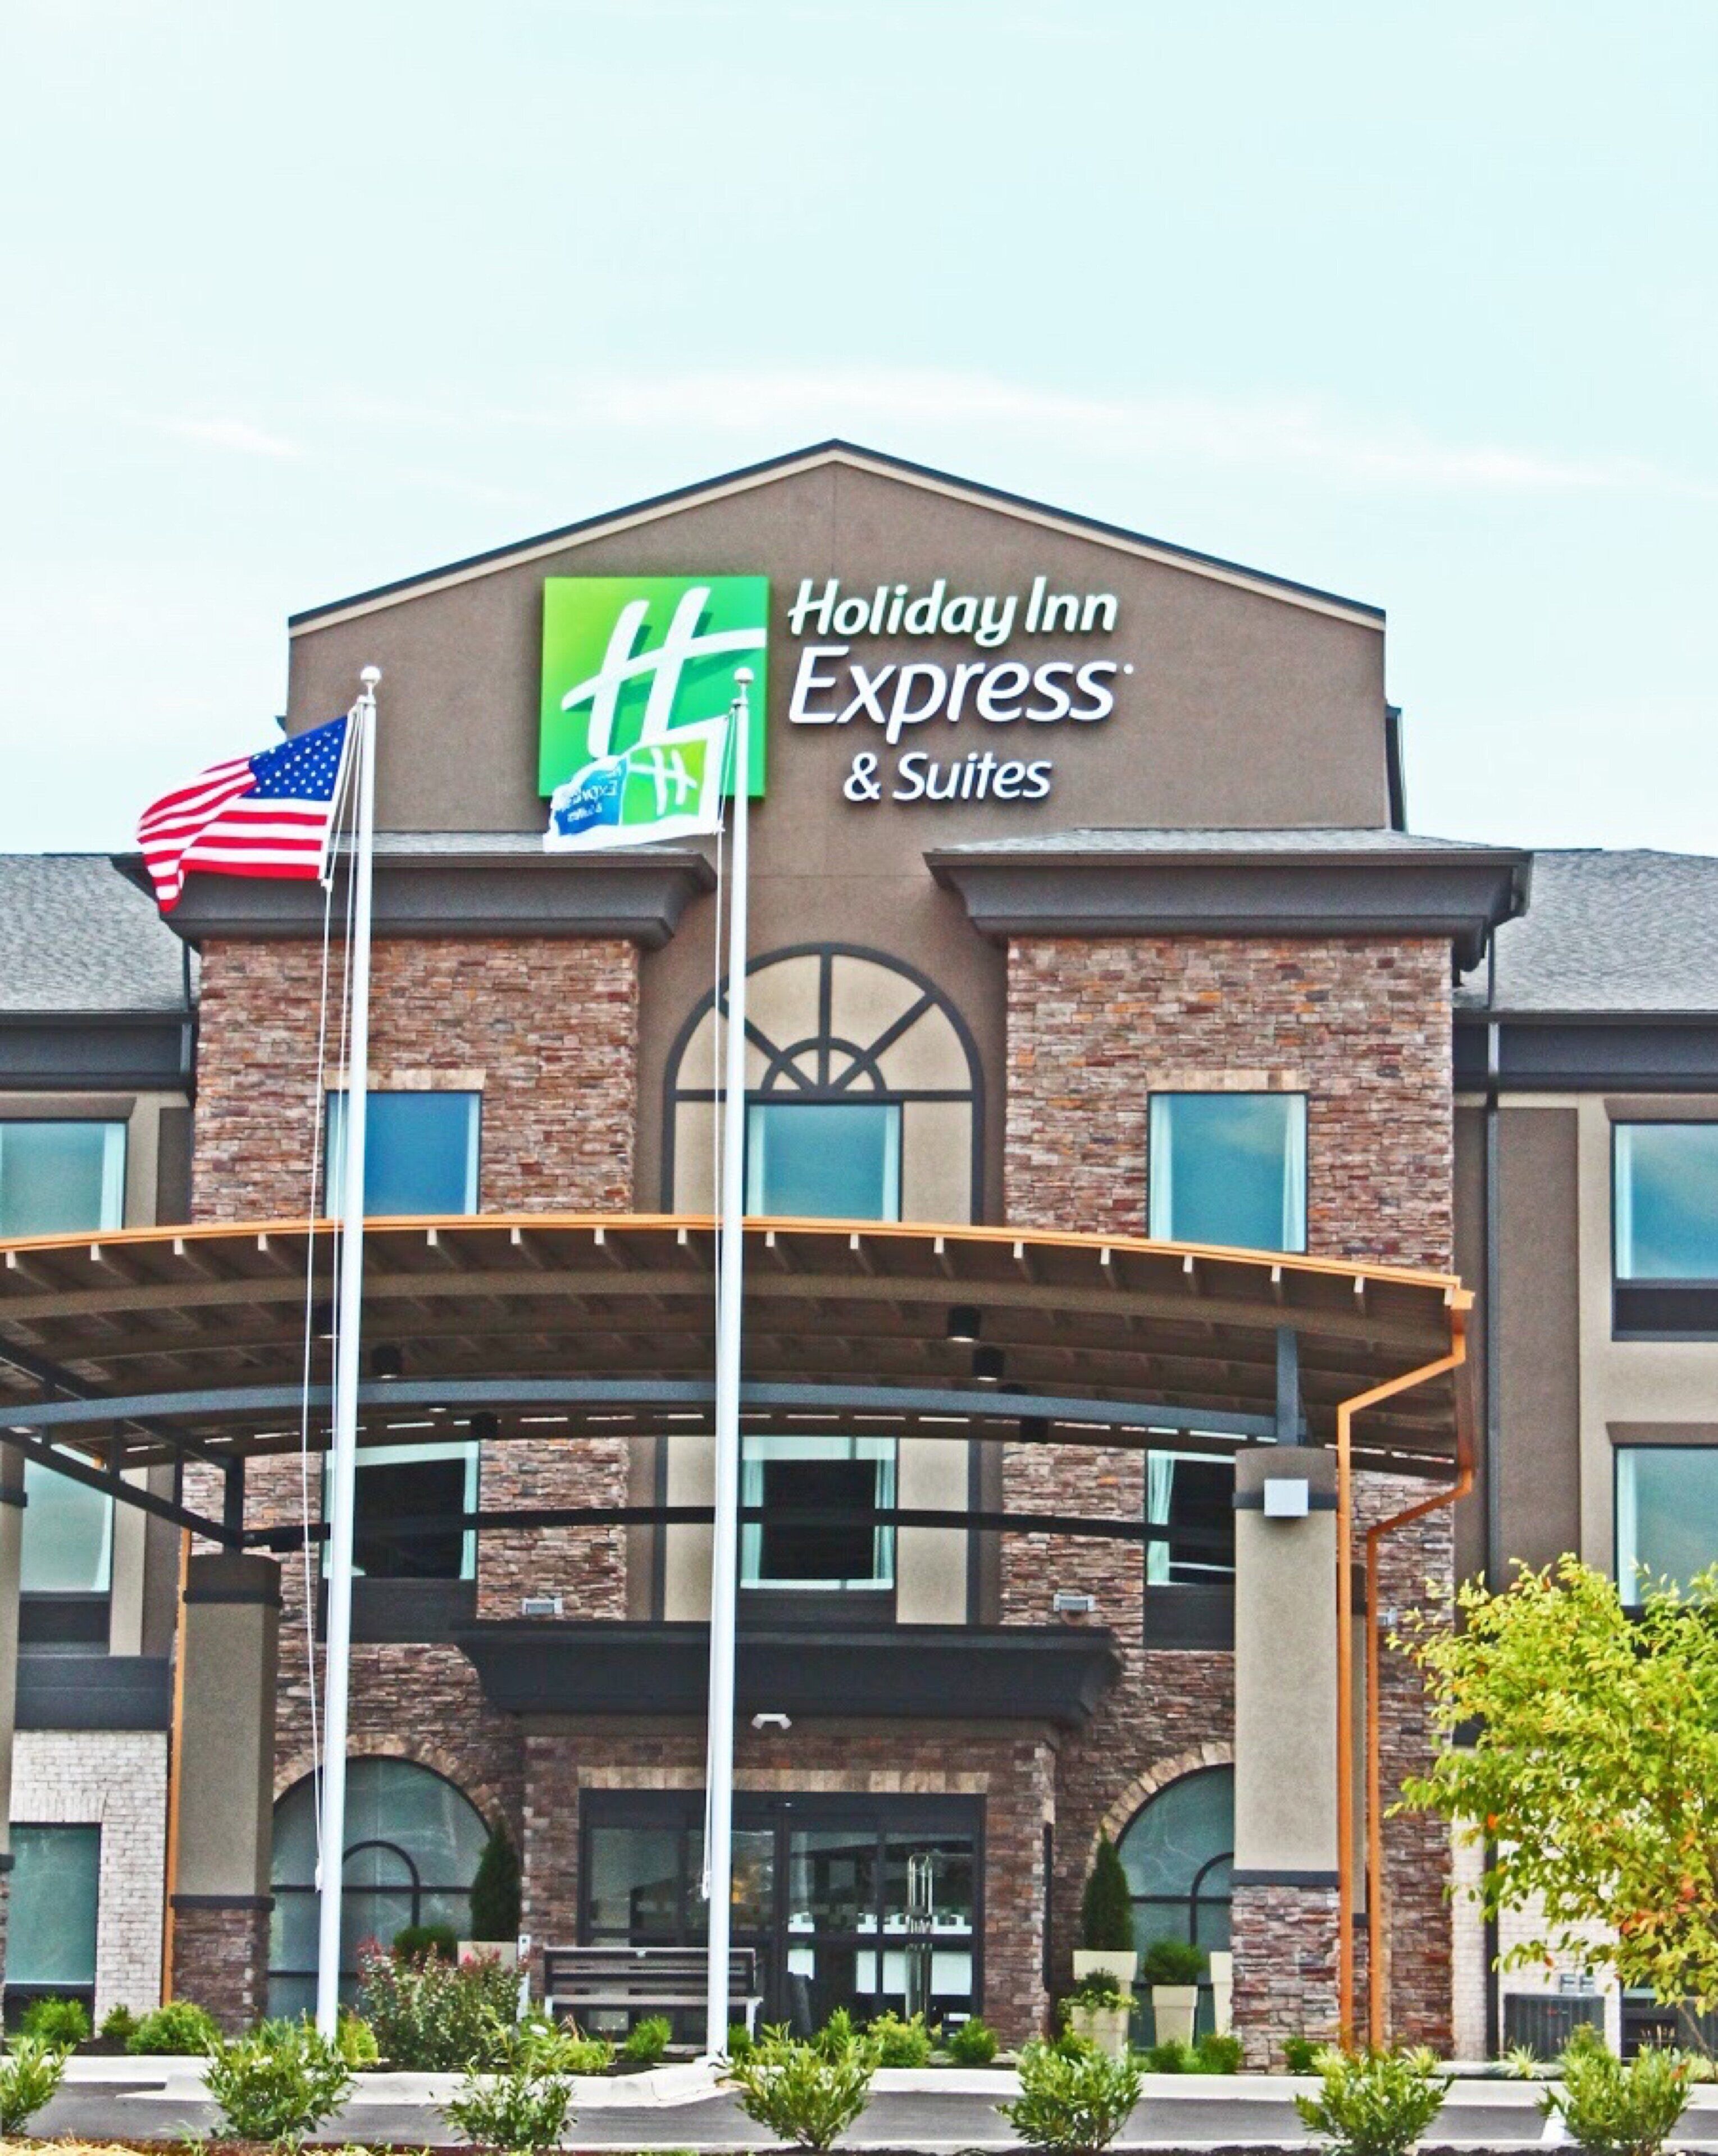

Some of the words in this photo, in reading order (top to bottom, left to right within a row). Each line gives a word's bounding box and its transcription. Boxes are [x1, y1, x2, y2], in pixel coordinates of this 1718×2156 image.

[787, 578, 1018, 647] Holiday
[1025, 575, 1118, 632] Inn
[789, 646, 1118, 745] Express
[843, 751, 881, 802] &
[892, 751, 1052, 801] Suites
